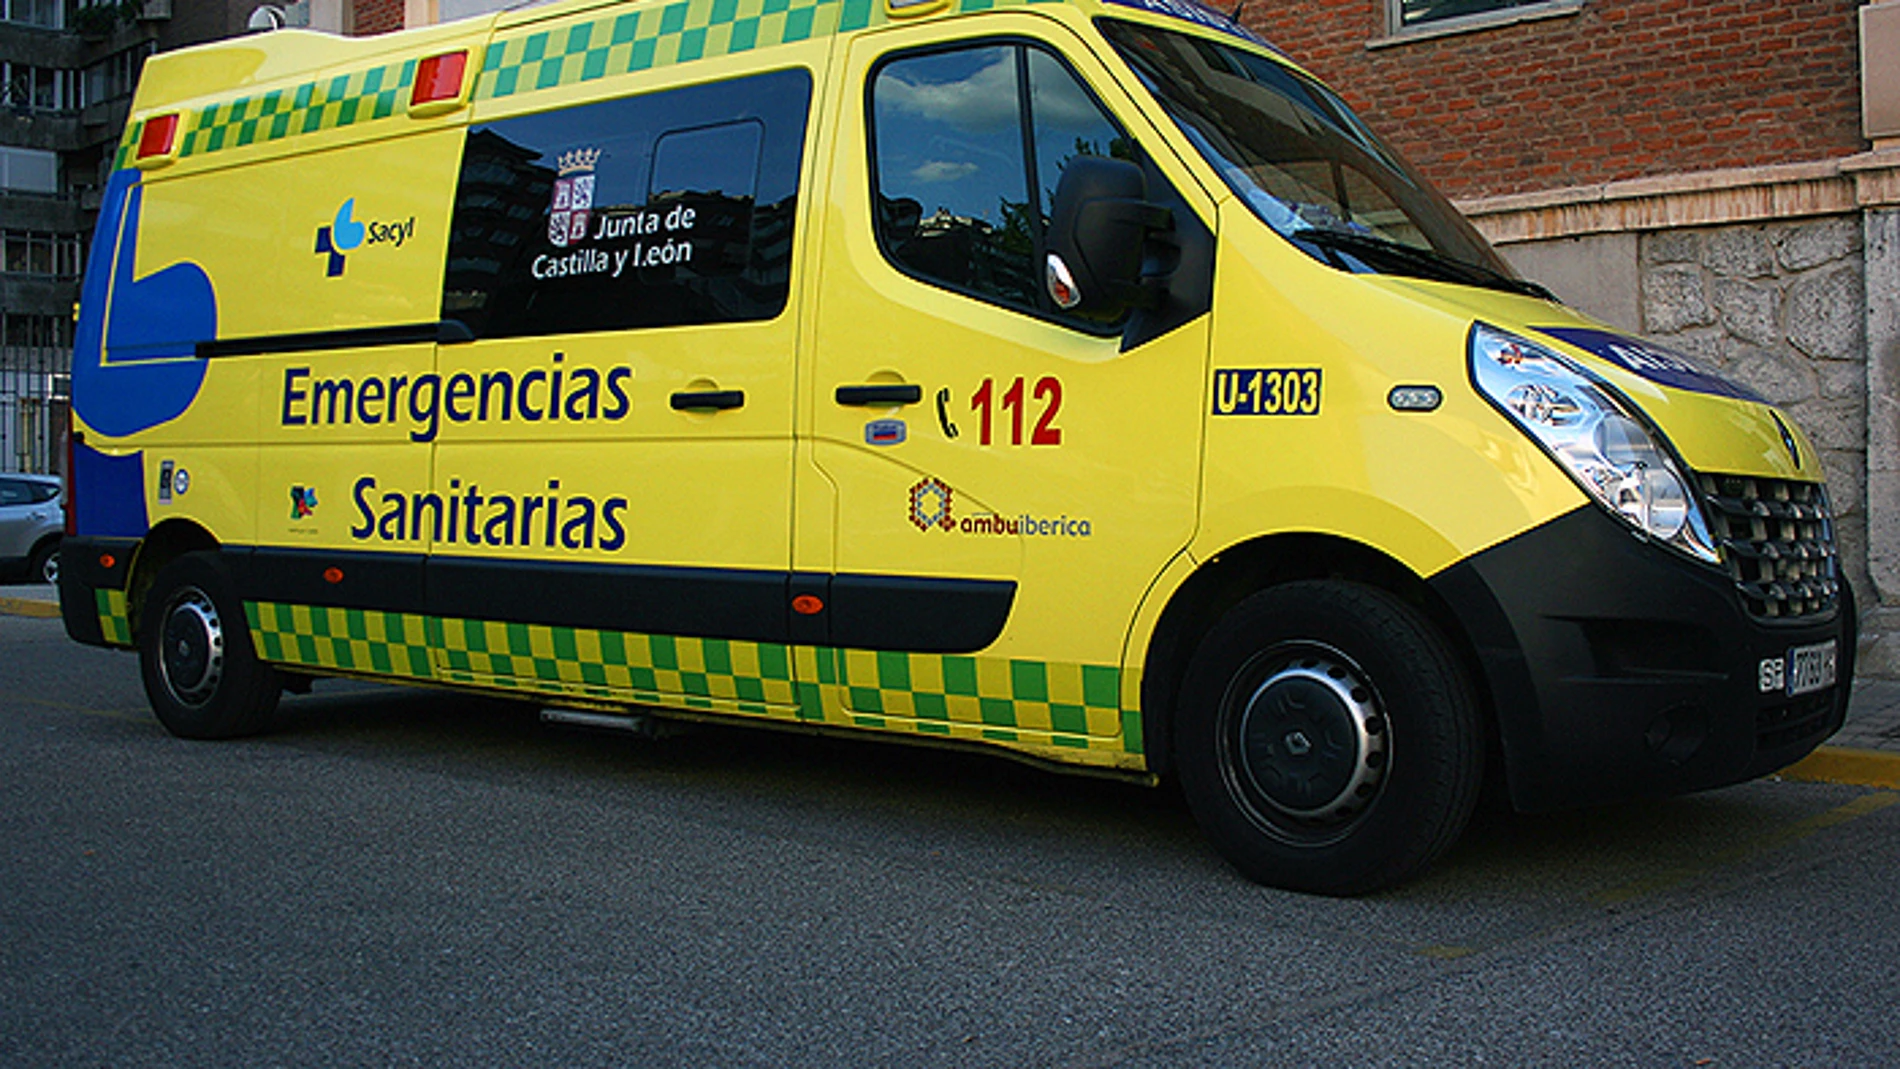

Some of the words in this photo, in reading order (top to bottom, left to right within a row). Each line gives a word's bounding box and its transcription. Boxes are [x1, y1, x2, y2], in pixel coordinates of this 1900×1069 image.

[367, 215, 416, 247] Sacyl
[593, 211, 659, 240] Junta
[664, 203, 697, 232] de
[531, 247, 609, 280] Castilla
[611, 249, 629, 278] y
[632, 237, 693, 268] León
[281, 352, 632, 443] Emergencias
[970, 376, 1063, 446] 112
[1217, 371, 1319, 414] U-1303
[350, 476, 629, 551] Sanitarias
[960, 513, 1093, 536] ambuiberica
